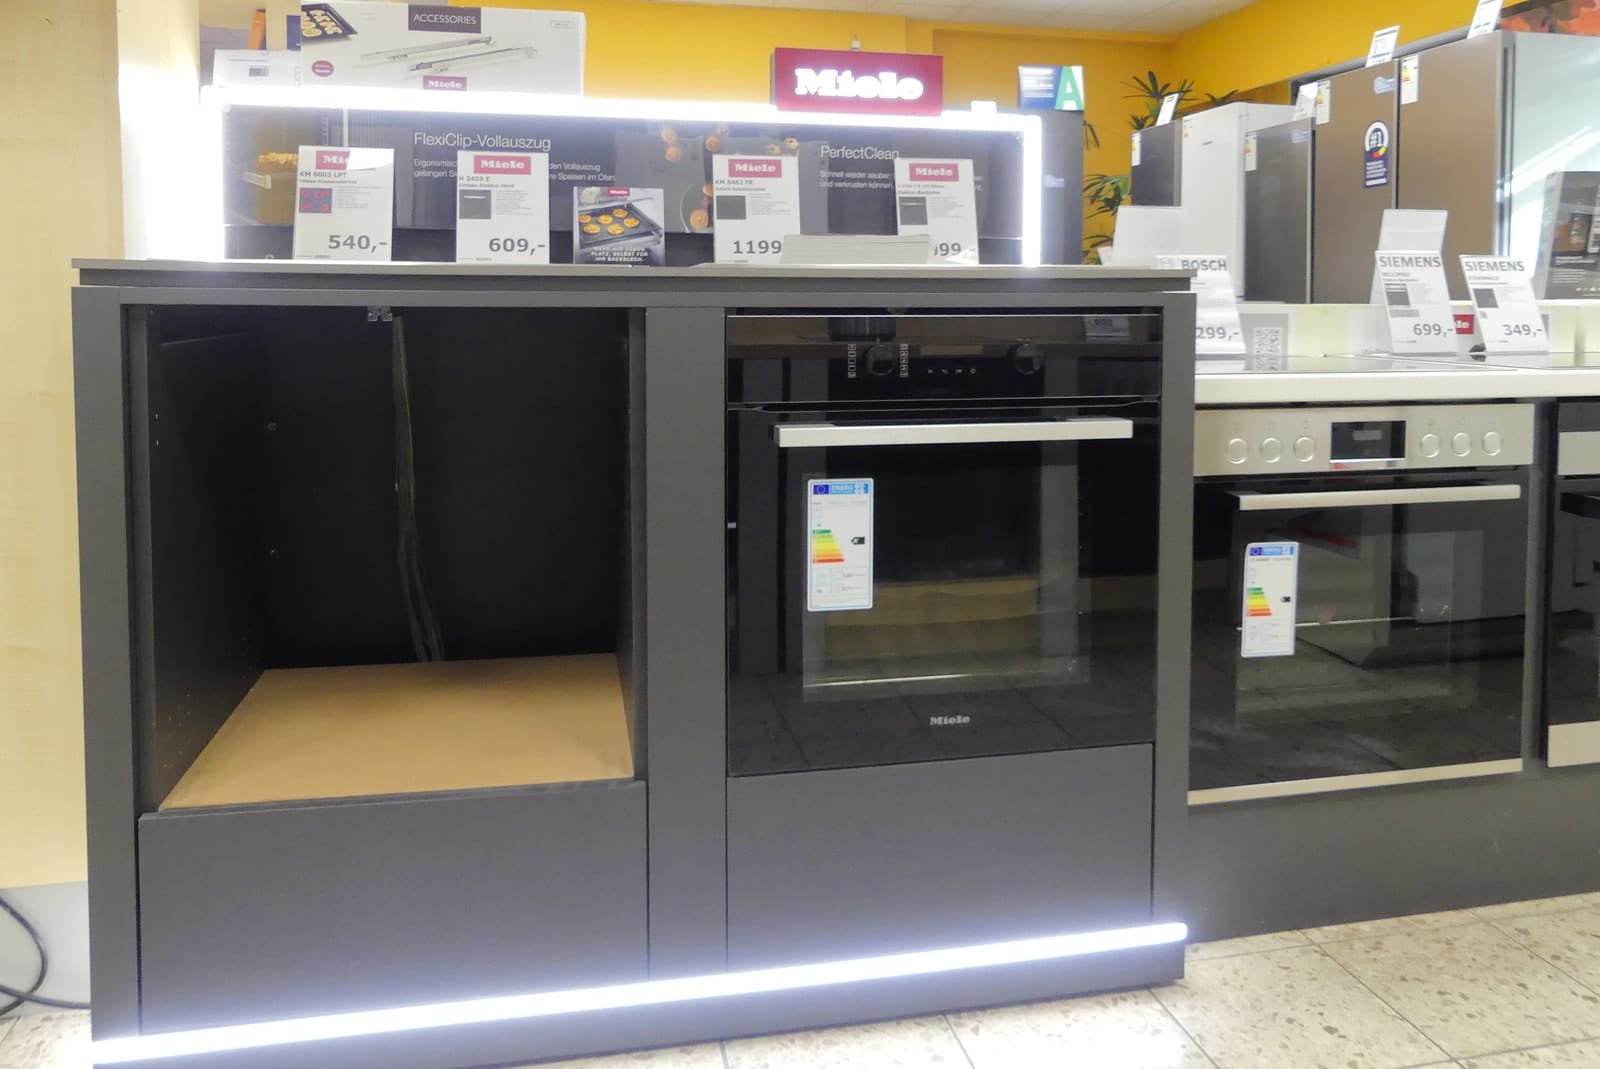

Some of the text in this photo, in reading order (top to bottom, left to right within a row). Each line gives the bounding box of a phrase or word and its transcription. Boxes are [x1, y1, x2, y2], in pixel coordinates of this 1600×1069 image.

[413, 13, 477, 25] ACCESSORIES
[428, 79, 462, 90] Miele
[795, 68, 924, 100] Miele
[414, 131, 551, 151] FlexiClip-Vollauszug
[820, 145, 899, 160] PerfectClean
[480, 160, 525, 169] Miele
[735, 163, 776, 172] Miele
[915, 167, 953, 176] Miele
[328, 235, 388, 253] 540,-
[488, 238, 545, 255] 609,-
[1181, 259, 1227, 271] BOSCH
[1379, 256, 1441, 268] SIEMENS
[1465, 261, 1525, 272] SIEMENS
[1413, 323, 1453, 338] 699,-
[1503, 324, 1542, 338] 349,-
[929, 715, 970, 725] Miele
